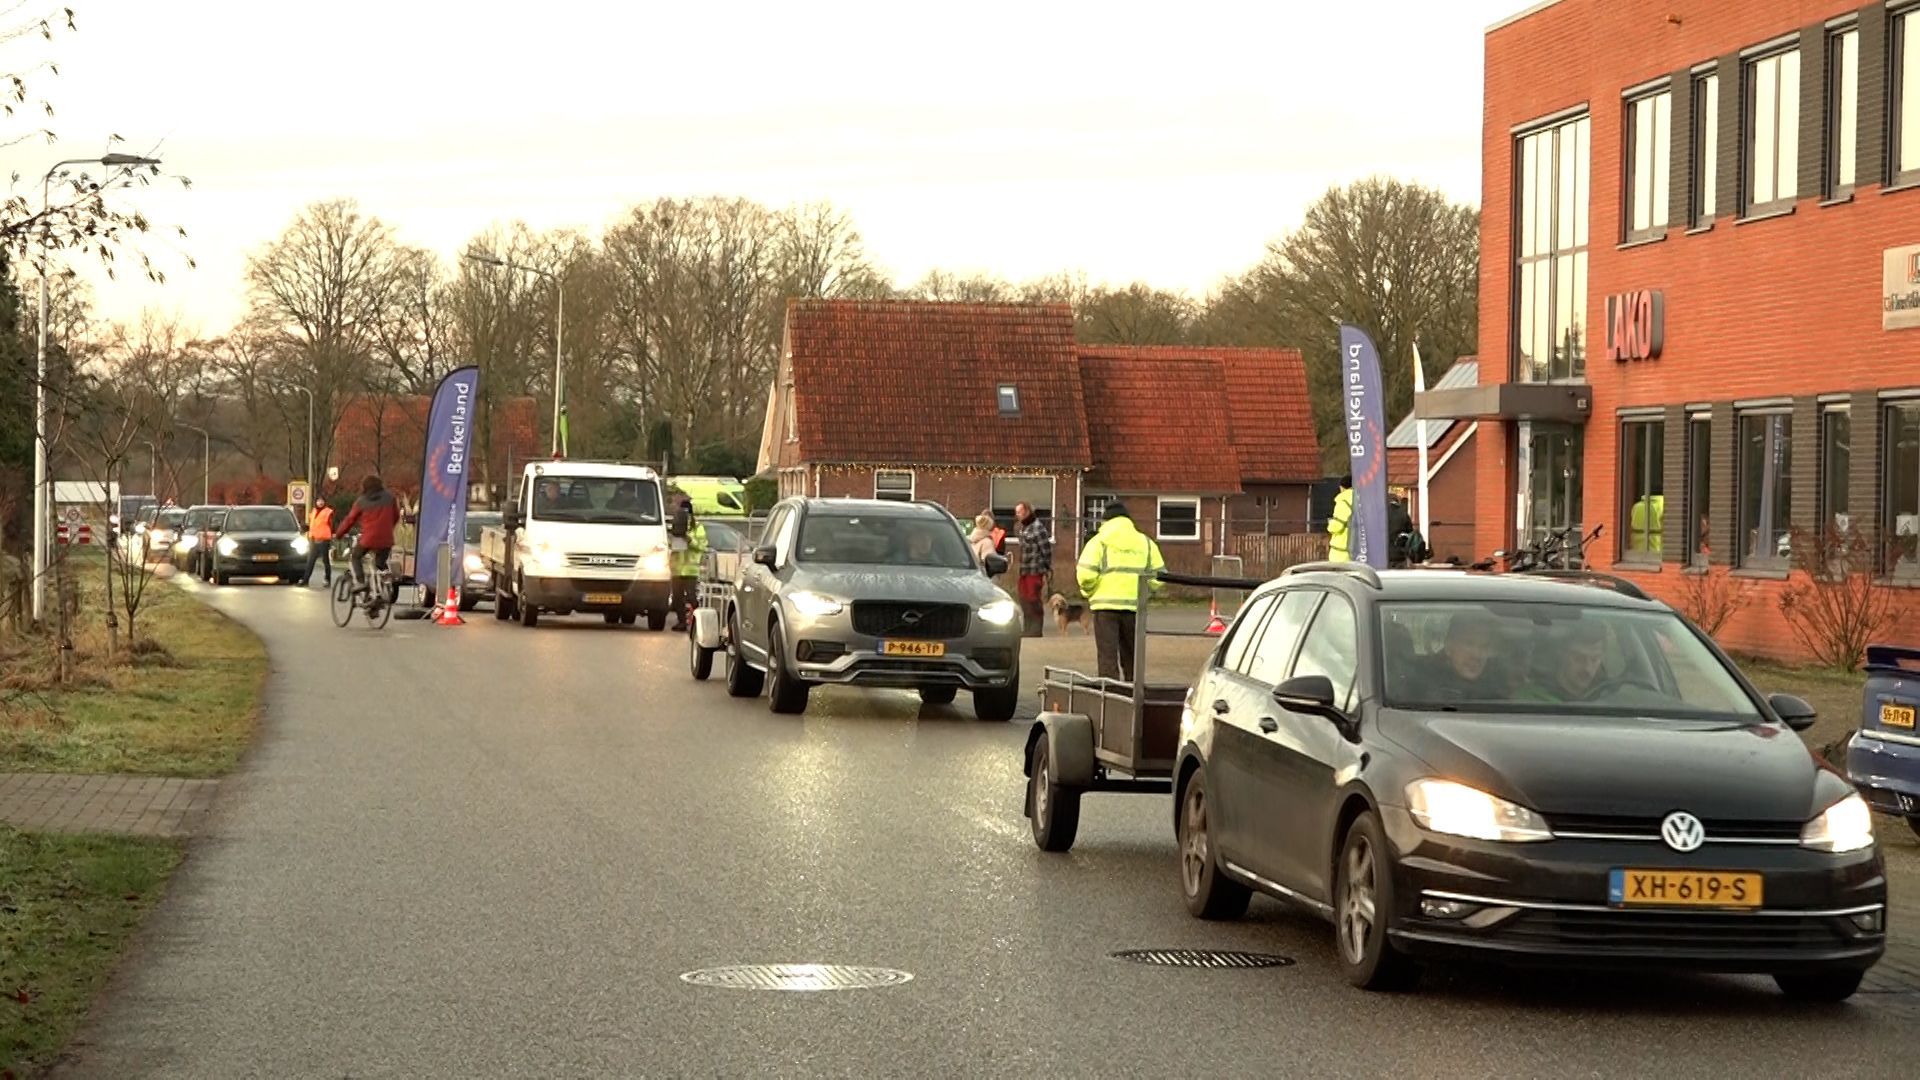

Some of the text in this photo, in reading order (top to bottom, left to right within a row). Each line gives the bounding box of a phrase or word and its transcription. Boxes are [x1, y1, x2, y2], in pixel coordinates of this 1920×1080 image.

[1604, 289, 1656, 360] LAKO
[447, 383, 470, 474] Berkelland
[888, 642, 940, 654] P-946-TP
[1632, 875, 1747, 901] XH-619-S
